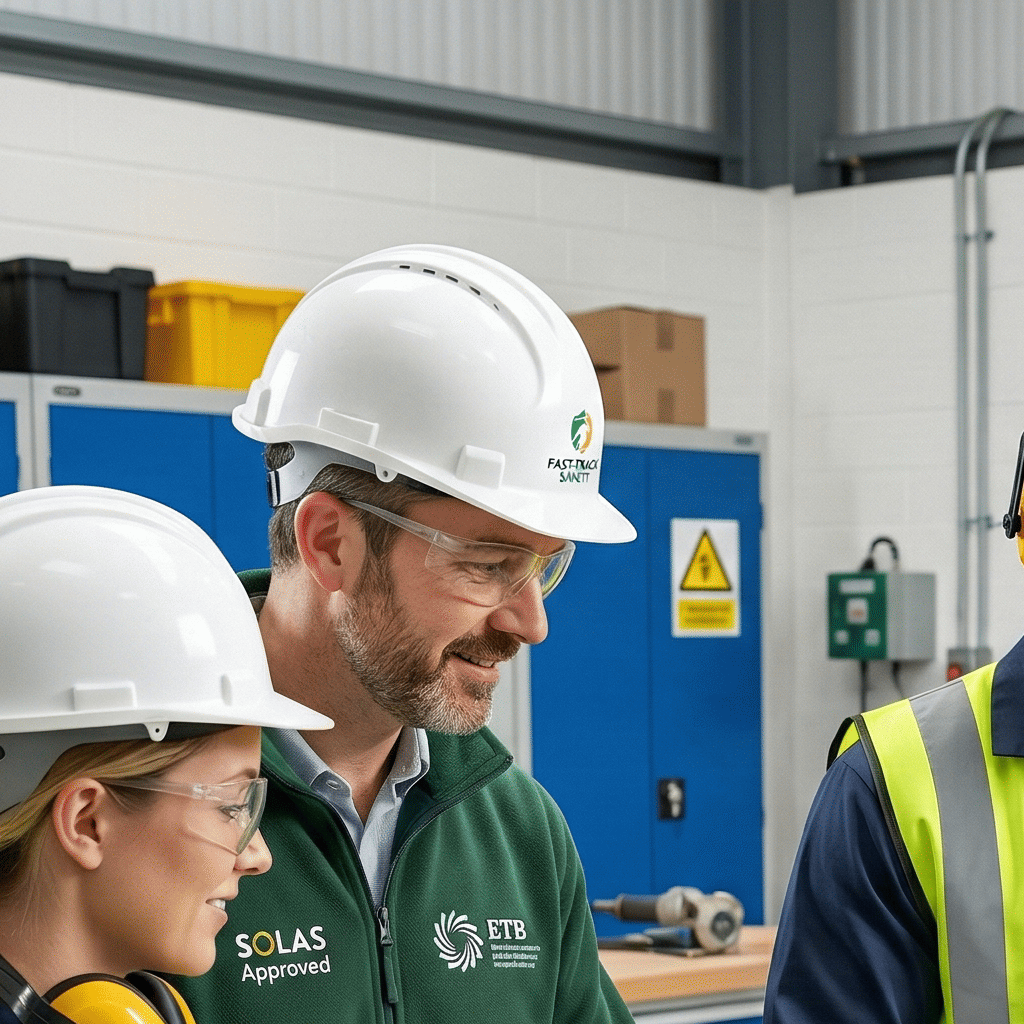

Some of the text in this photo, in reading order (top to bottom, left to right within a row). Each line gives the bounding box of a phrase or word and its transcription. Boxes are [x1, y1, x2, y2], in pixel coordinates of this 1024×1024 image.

[235, 925, 327, 958] SOLAS
[486, 919, 527, 940] ETB
[241, 954, 331, 987] Approved
